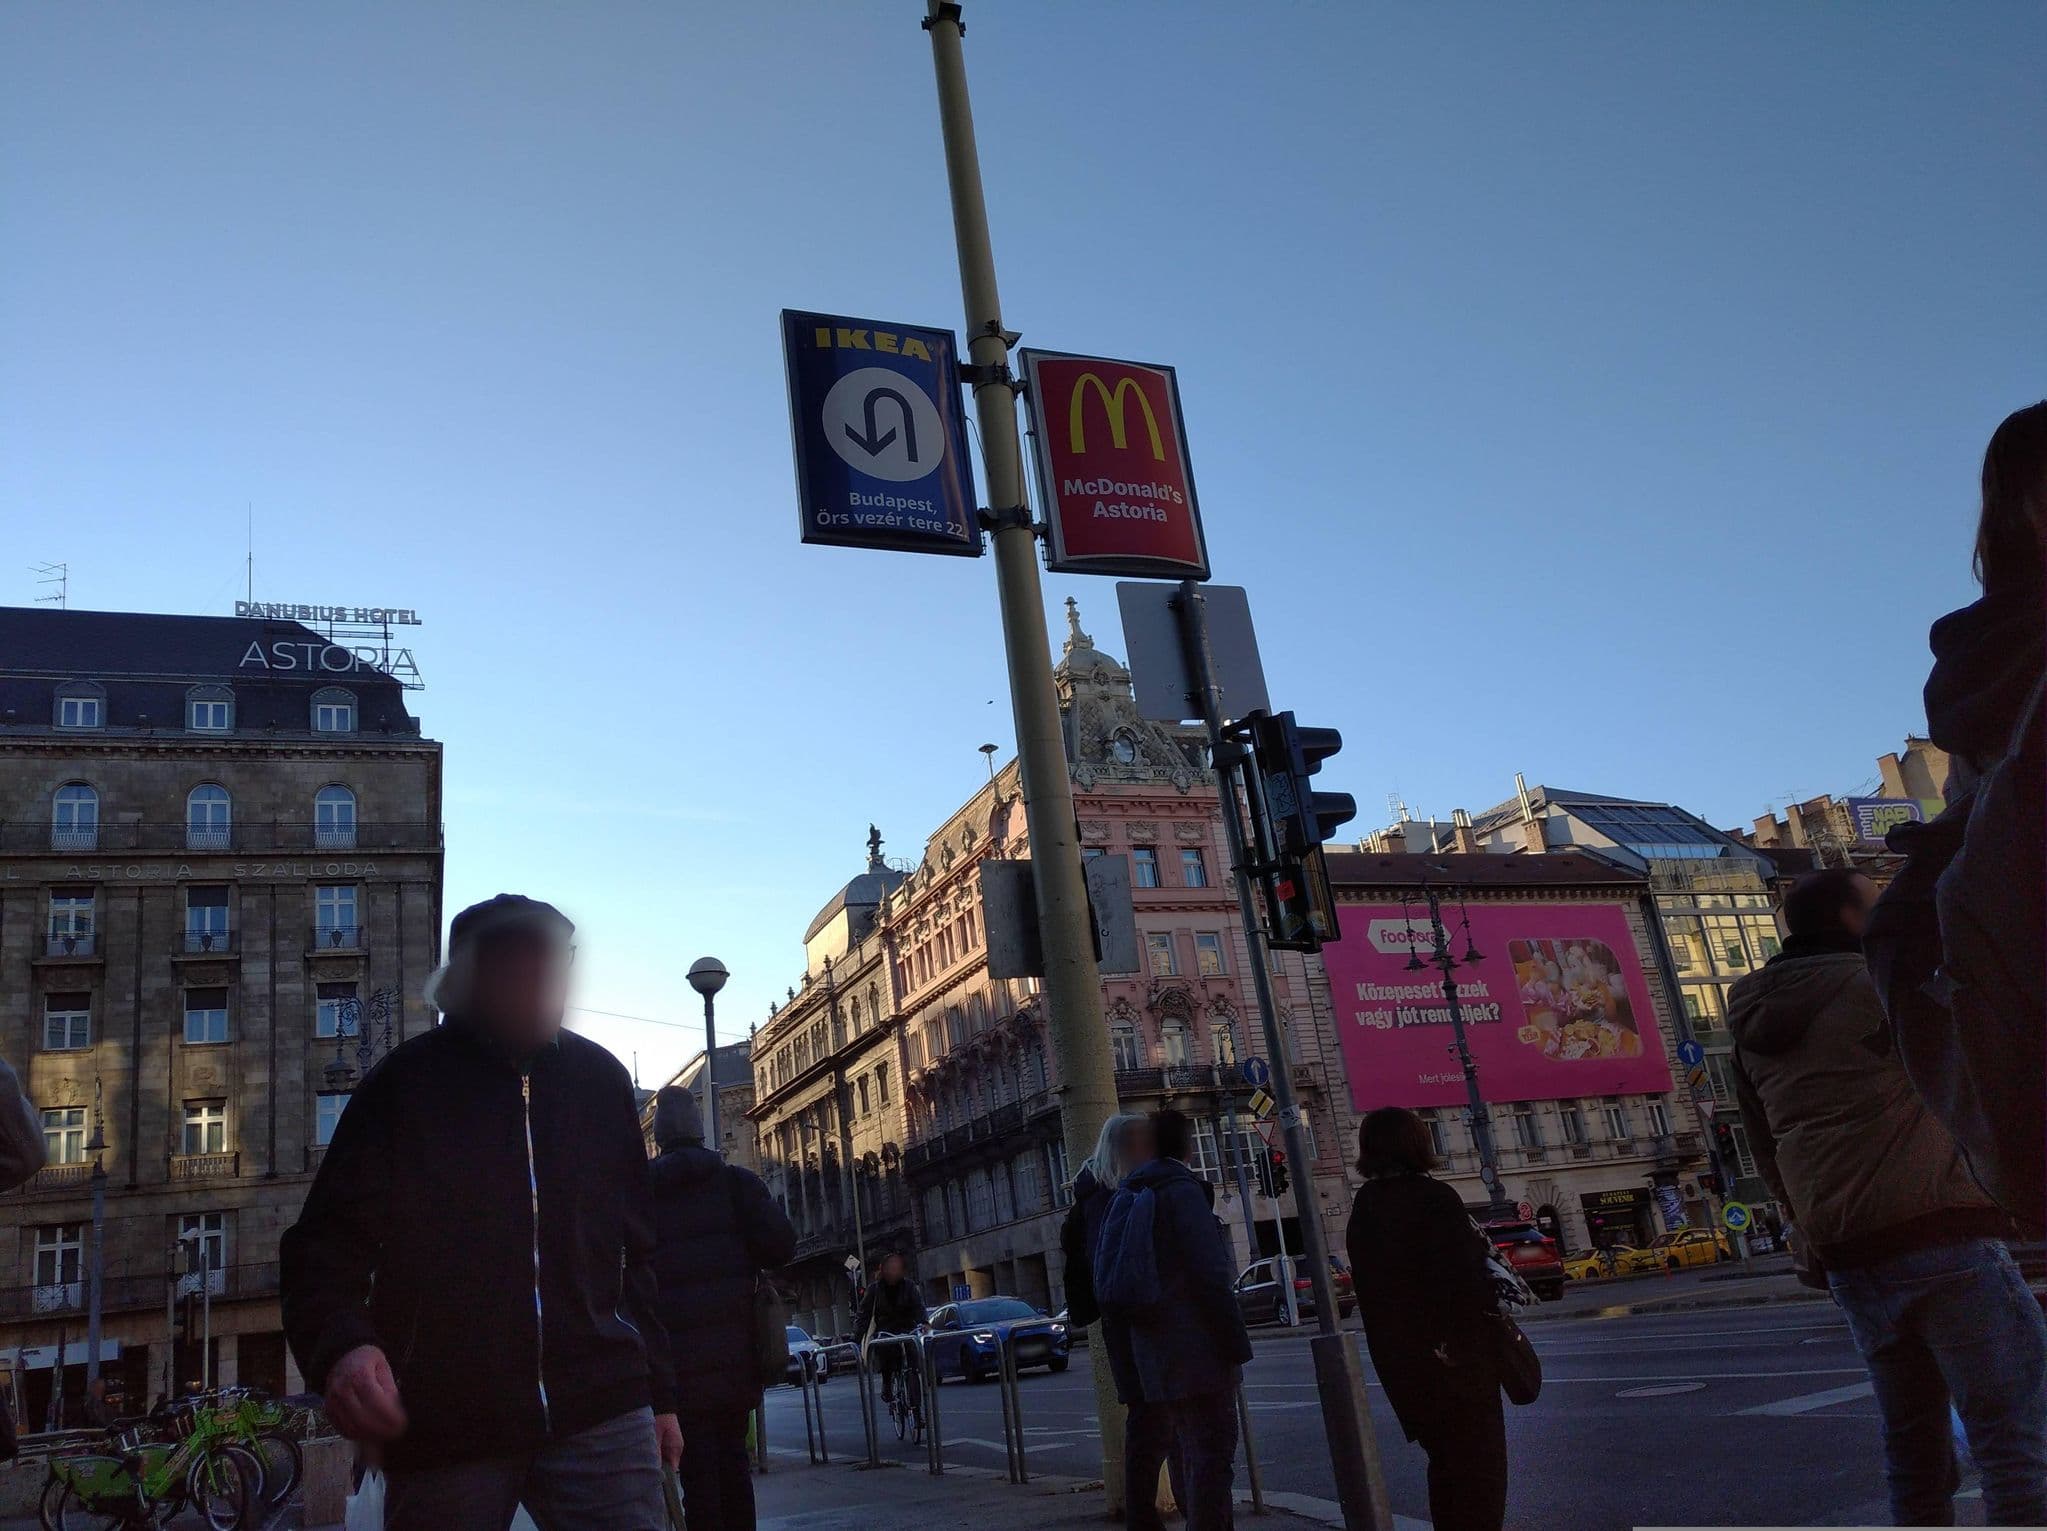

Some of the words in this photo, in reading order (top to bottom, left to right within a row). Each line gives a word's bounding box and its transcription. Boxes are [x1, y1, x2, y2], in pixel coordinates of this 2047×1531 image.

[815, 328, 932, 362] IKEA
[1064, 478, 1183, 504] McDonald's
[849, 492, 938, 515] Budapest,
[1093, 500, 1168, 522] Astoria
[816, 508, 850, 526] Örs
[854, 511, 904, 527] vezér
[907, 515, 943, 532] tere
[235, 600, 348, 622] DANUBIUS
[354, 607, 422, 625] HOTEL
[238, 640, 419, 675] ASTORIA
[65, 863, 194, 880] ASTORIA
[1356, 981, 1439, 1003] Közepeset
[1355, 1007, 1393, 1030] vagy
[1395, 1006, 1419, 1028] jót
